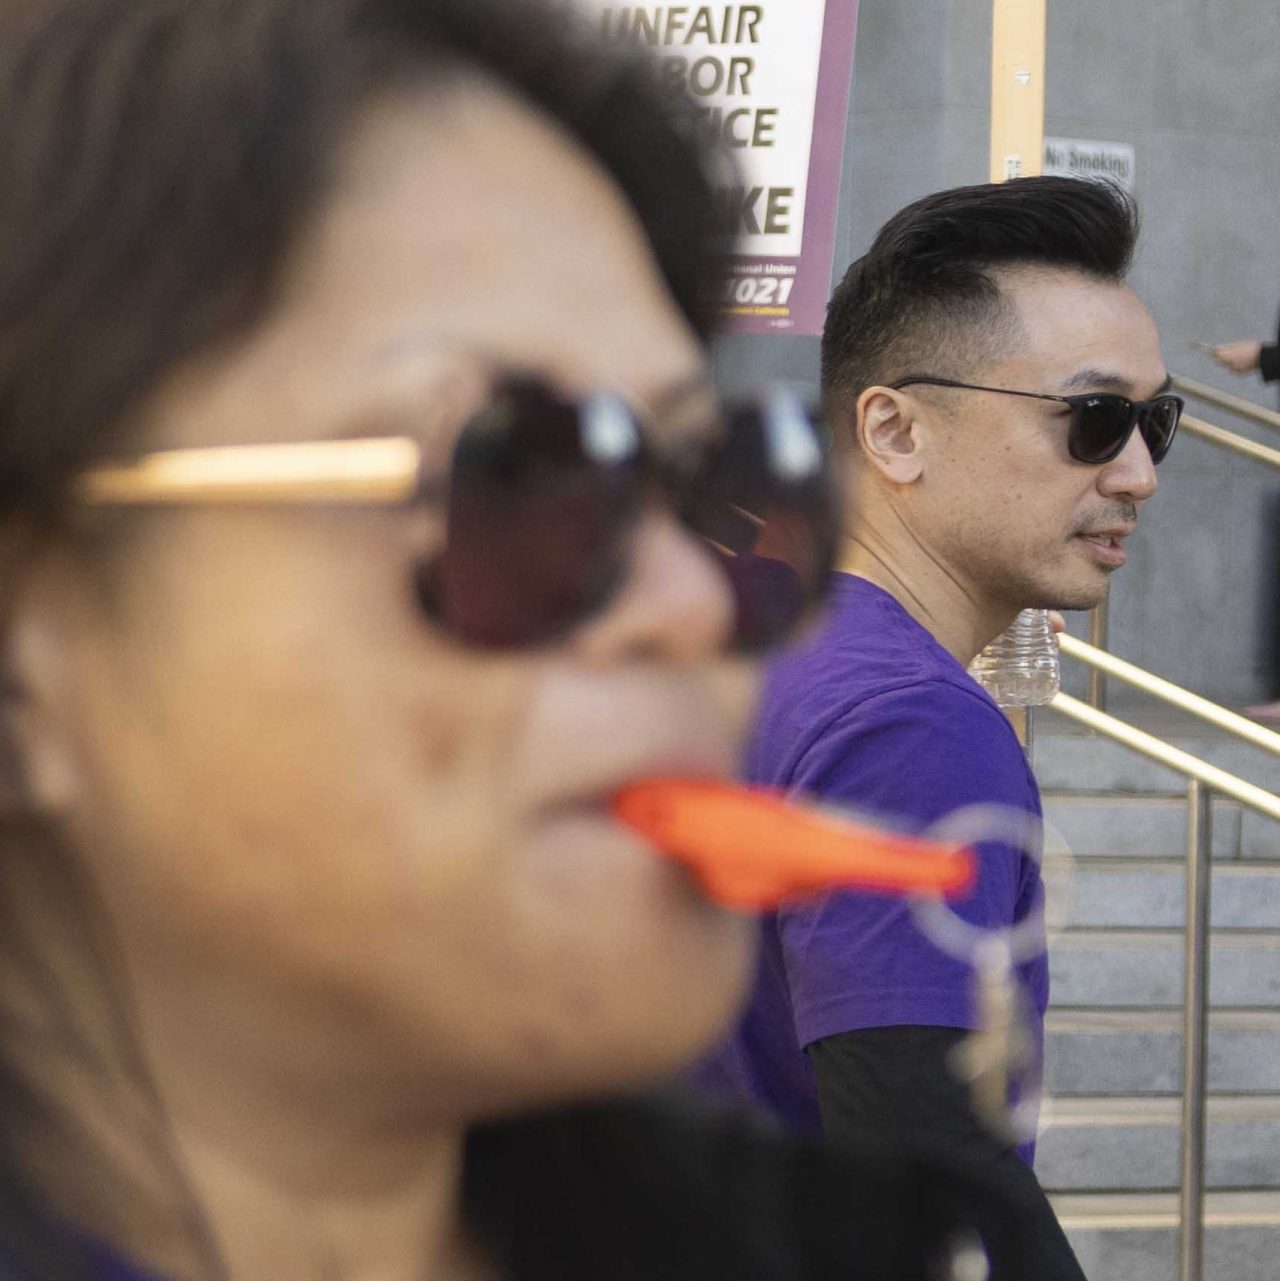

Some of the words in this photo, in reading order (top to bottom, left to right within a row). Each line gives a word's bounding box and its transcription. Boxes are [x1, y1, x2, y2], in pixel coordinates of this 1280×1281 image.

[601, 5, 765, 47] UNFAIR
[1045, 144, 1066, 166] No
[1069, 146, 1127, 178] Smoking
